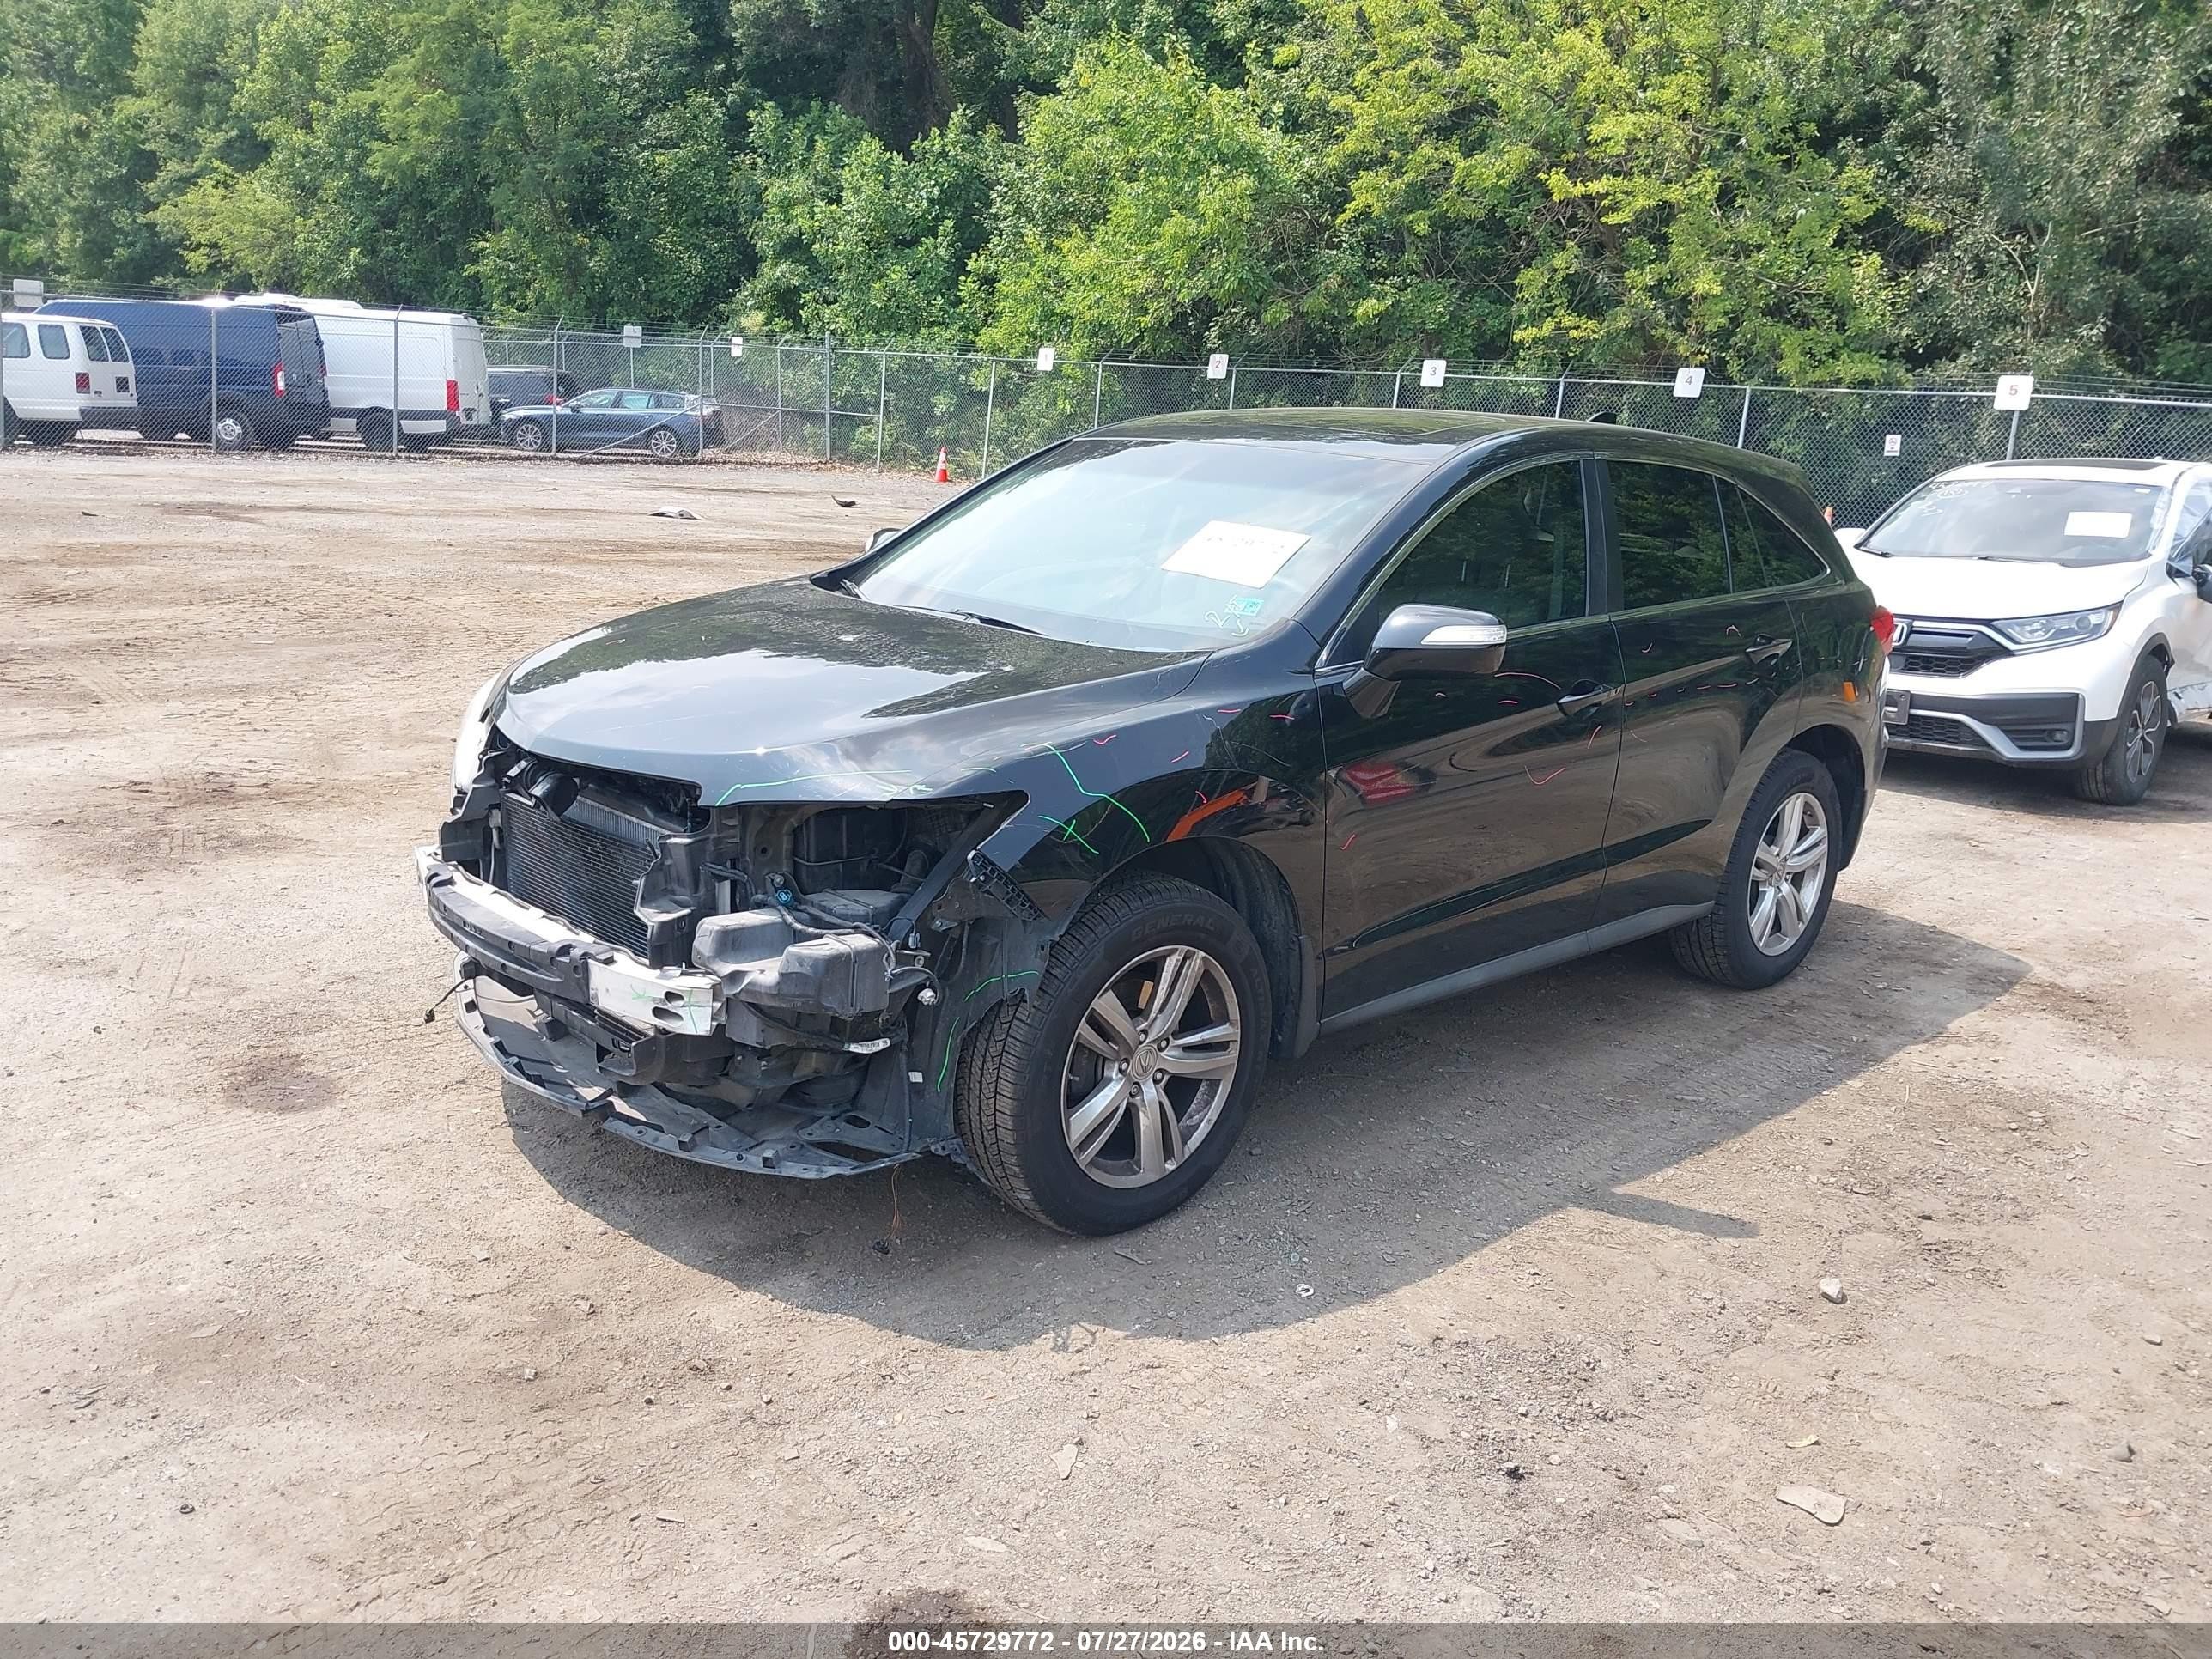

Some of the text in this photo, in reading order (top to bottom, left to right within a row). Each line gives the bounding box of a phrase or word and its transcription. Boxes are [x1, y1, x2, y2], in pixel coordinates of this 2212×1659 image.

[1215, 360, 1221, 369] 2
[1430, 366, 1437, 376] 3
[1685, 375, 1693, 386] 4
[2008, 384, 2020, 396] 5
[1133, 912, 1218, 939] GENERAL
